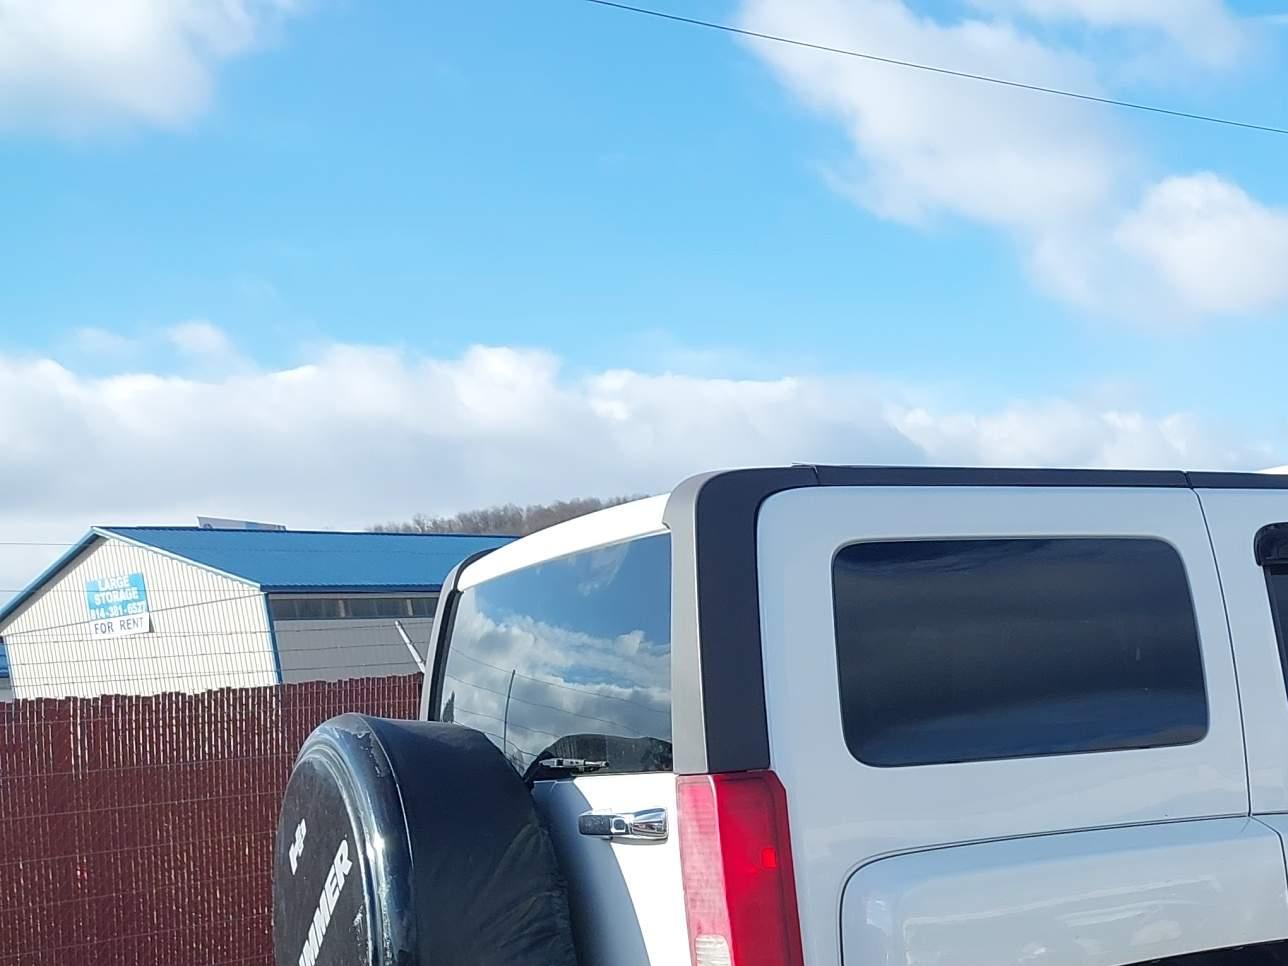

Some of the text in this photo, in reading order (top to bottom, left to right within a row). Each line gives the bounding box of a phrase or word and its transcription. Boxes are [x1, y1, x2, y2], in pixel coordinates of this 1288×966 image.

[98, 576, 129, 591] LARGE
[94, 587, 139, 605] STORAGE
[94, 617, 144, 634] FOR RENT
